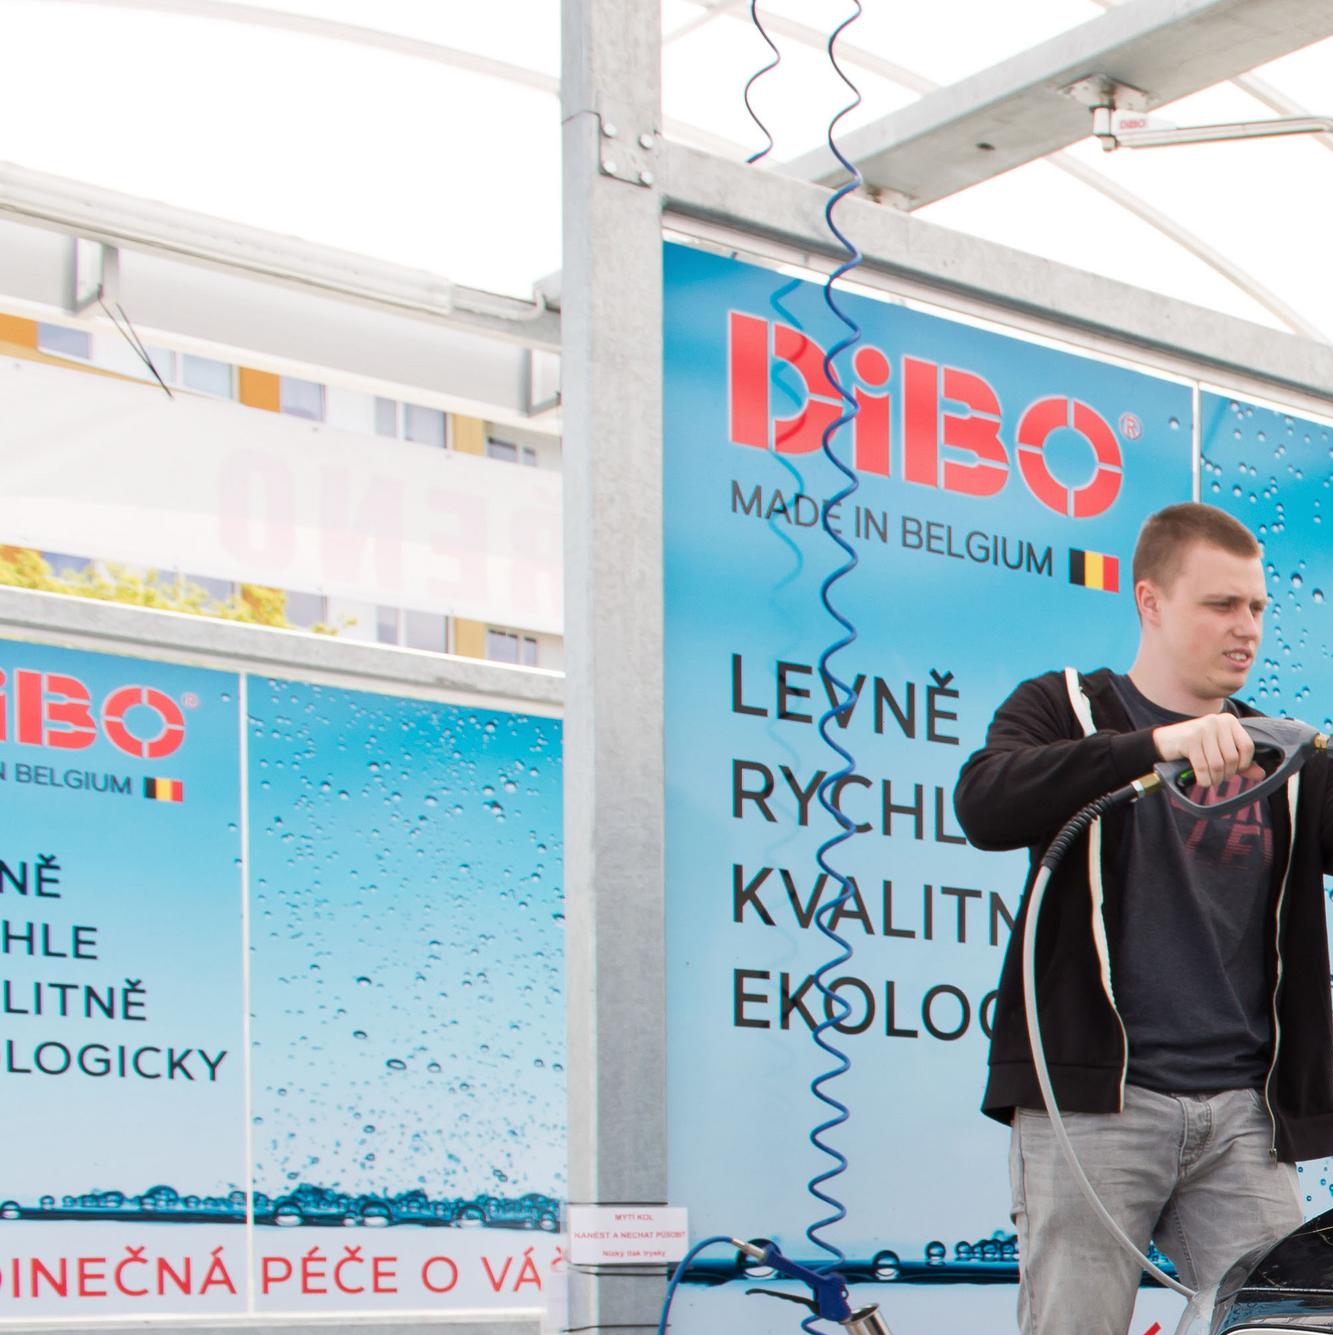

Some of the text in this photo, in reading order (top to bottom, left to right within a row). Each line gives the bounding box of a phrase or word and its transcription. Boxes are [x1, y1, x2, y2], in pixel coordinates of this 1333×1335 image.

[731, 480, 1054, 577] MADE IN BELGIUM
[0, 666, 186, 760] BO
[732, 653, 960, 746] LEVNĚ
[15, 763, 133, 795] BELGIUM
[732, 759, 967, 845] RYCHL
[732, 863, 1015, 947] KVALITN
[2, 919, 98, 960] HLE
[4, 978, 147, 1021] LITNĚ
[6, 1039, 228, 1082] LOGICKY
[0, 1245, 237, 1298] INEČNÁ
[261, 1246, 399, 1295] PÉČE
[421, 1256, 459, 1294] O
